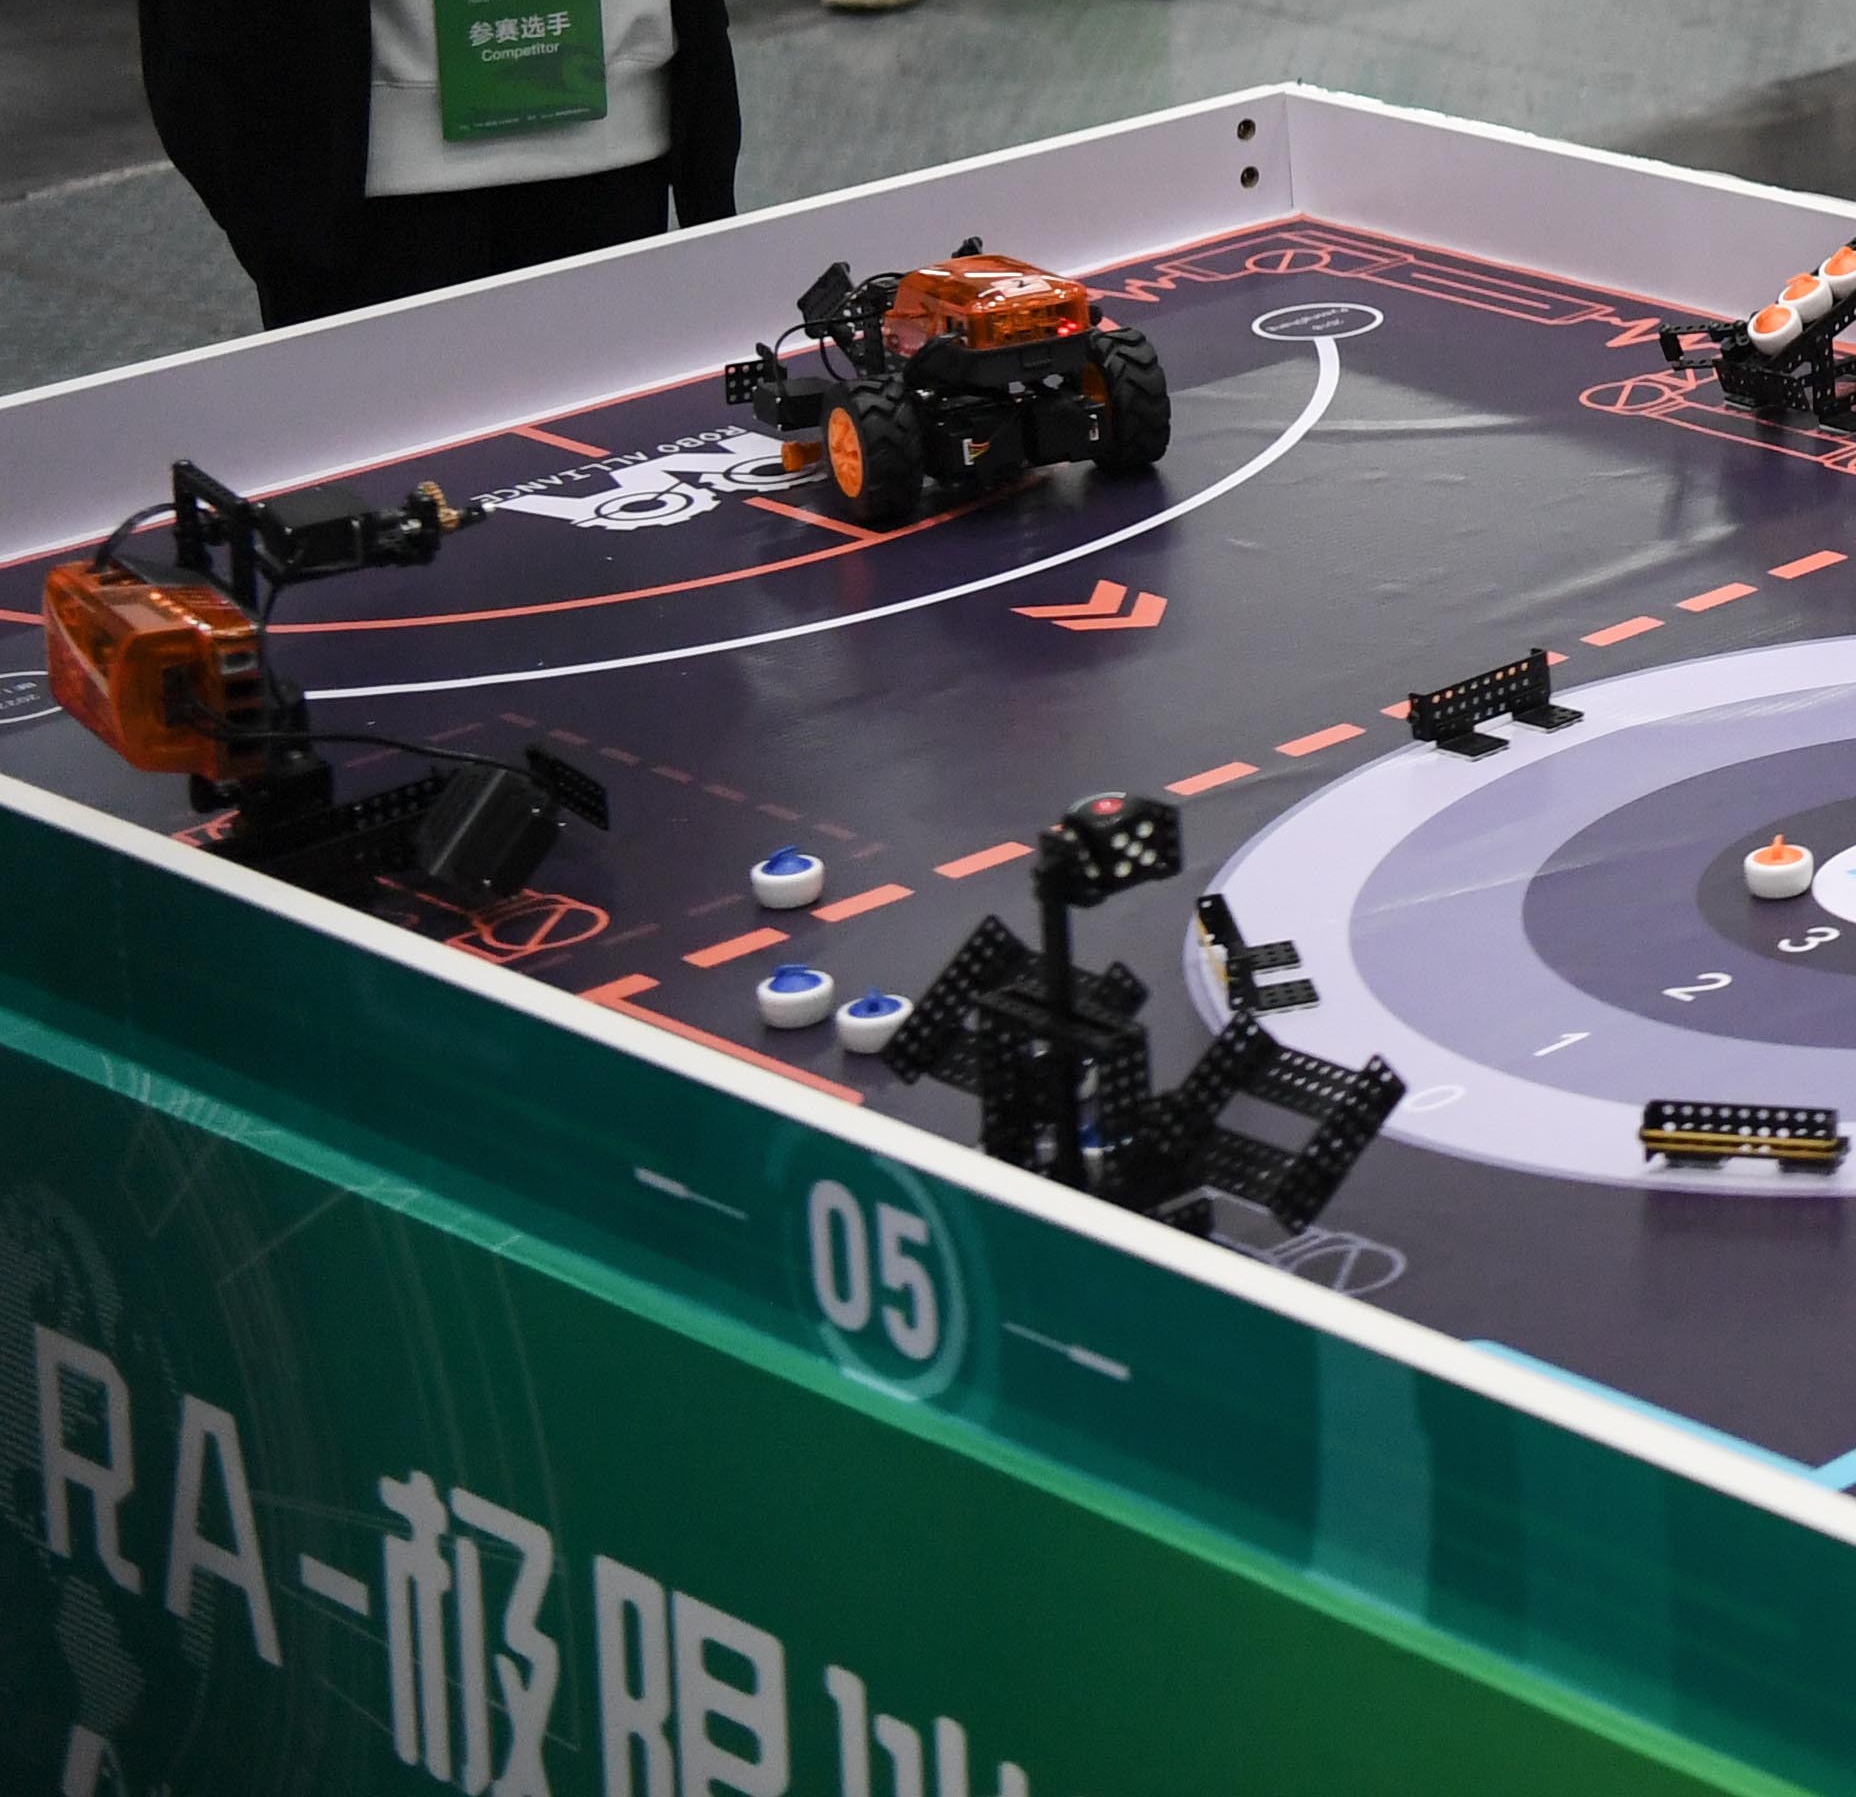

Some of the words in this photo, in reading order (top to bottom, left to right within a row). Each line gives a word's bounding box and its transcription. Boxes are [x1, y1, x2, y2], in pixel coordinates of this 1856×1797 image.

[468, 10, 571, 47] 参赛选手
[480, 41, 561, 63] Competitor
[657, 425, 748, 454] ROBO
[470, 450, 649, 506] ALLIANCE
[1776, 926, 1841, 953] 3
[1661, 971, 1733, 1002] 2
[1532, 1030, 1592, 1057] 1
[807, 1178, 941, 1362] 05
